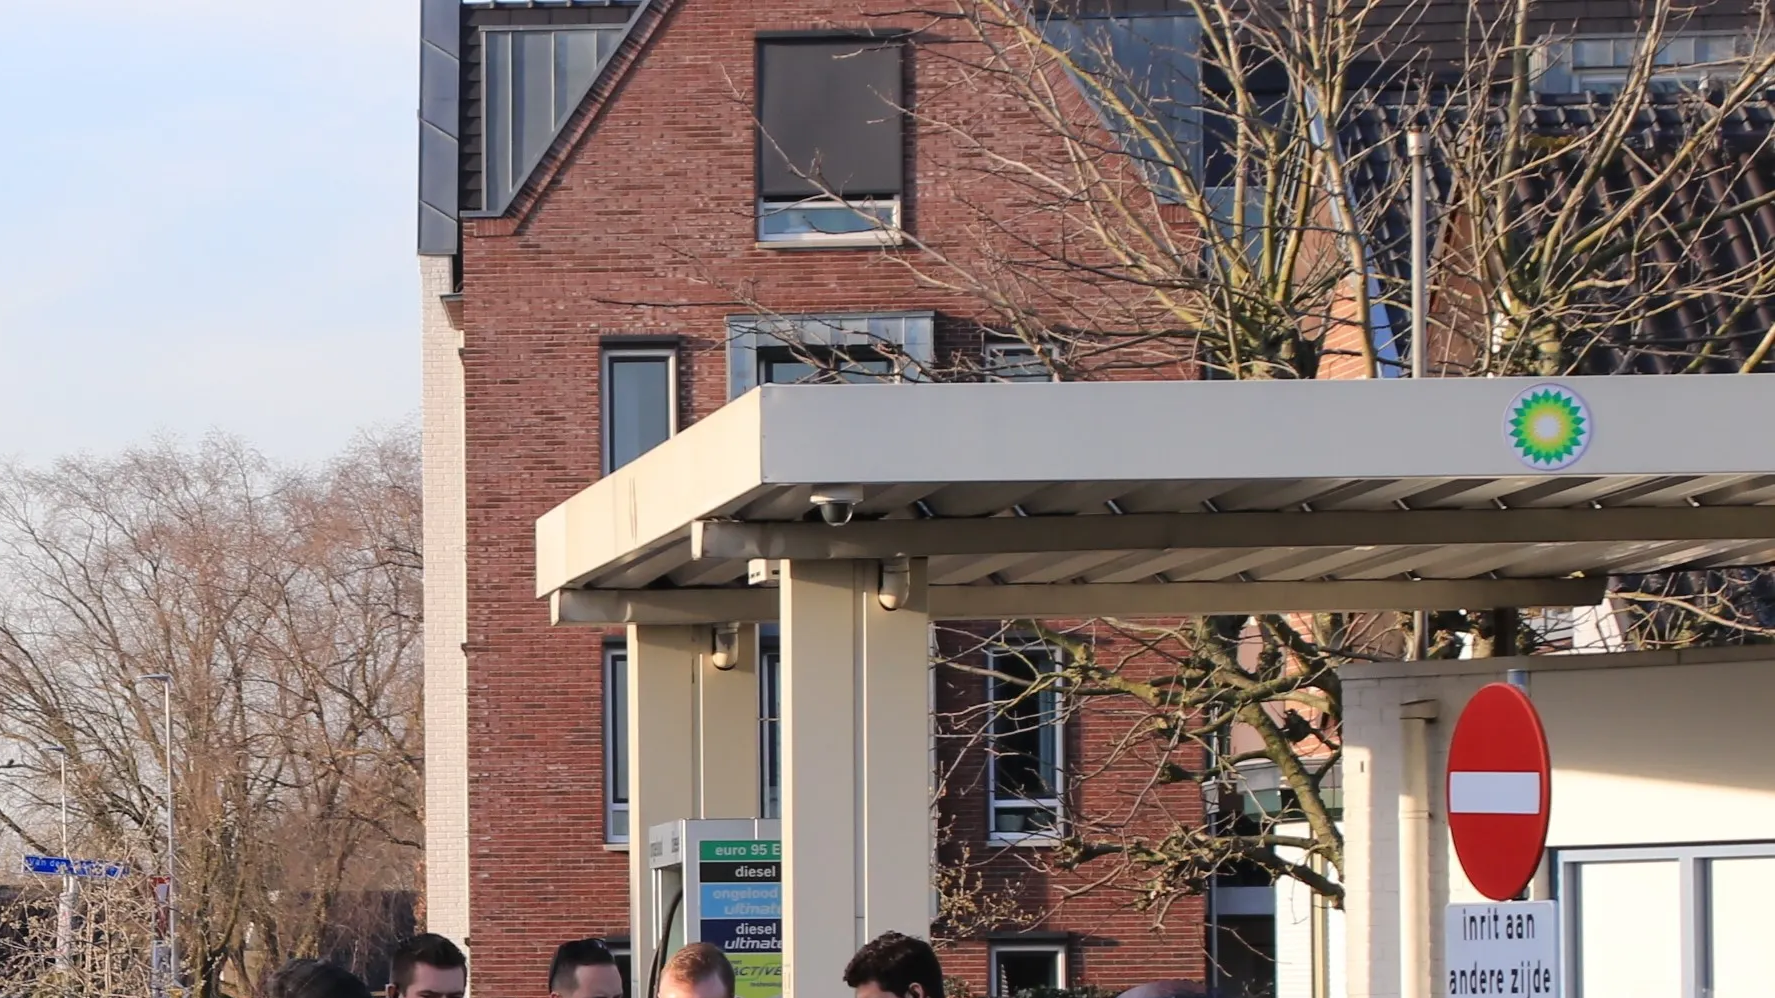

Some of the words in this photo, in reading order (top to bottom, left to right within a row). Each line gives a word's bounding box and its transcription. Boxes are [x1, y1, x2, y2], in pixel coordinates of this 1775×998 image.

[715, 846, 746, 856] euro
[750, 843, 768, 856] 95
[735, 865, 776, 878] diesel
[713, 887, 778, 901] ongelood
[735, 922, 777, 935] diesel
[1462, 907, 1499, 941] inrit
[1506, 913, 1535, 940] aan
[1449, 960, 1504, 995] andere
